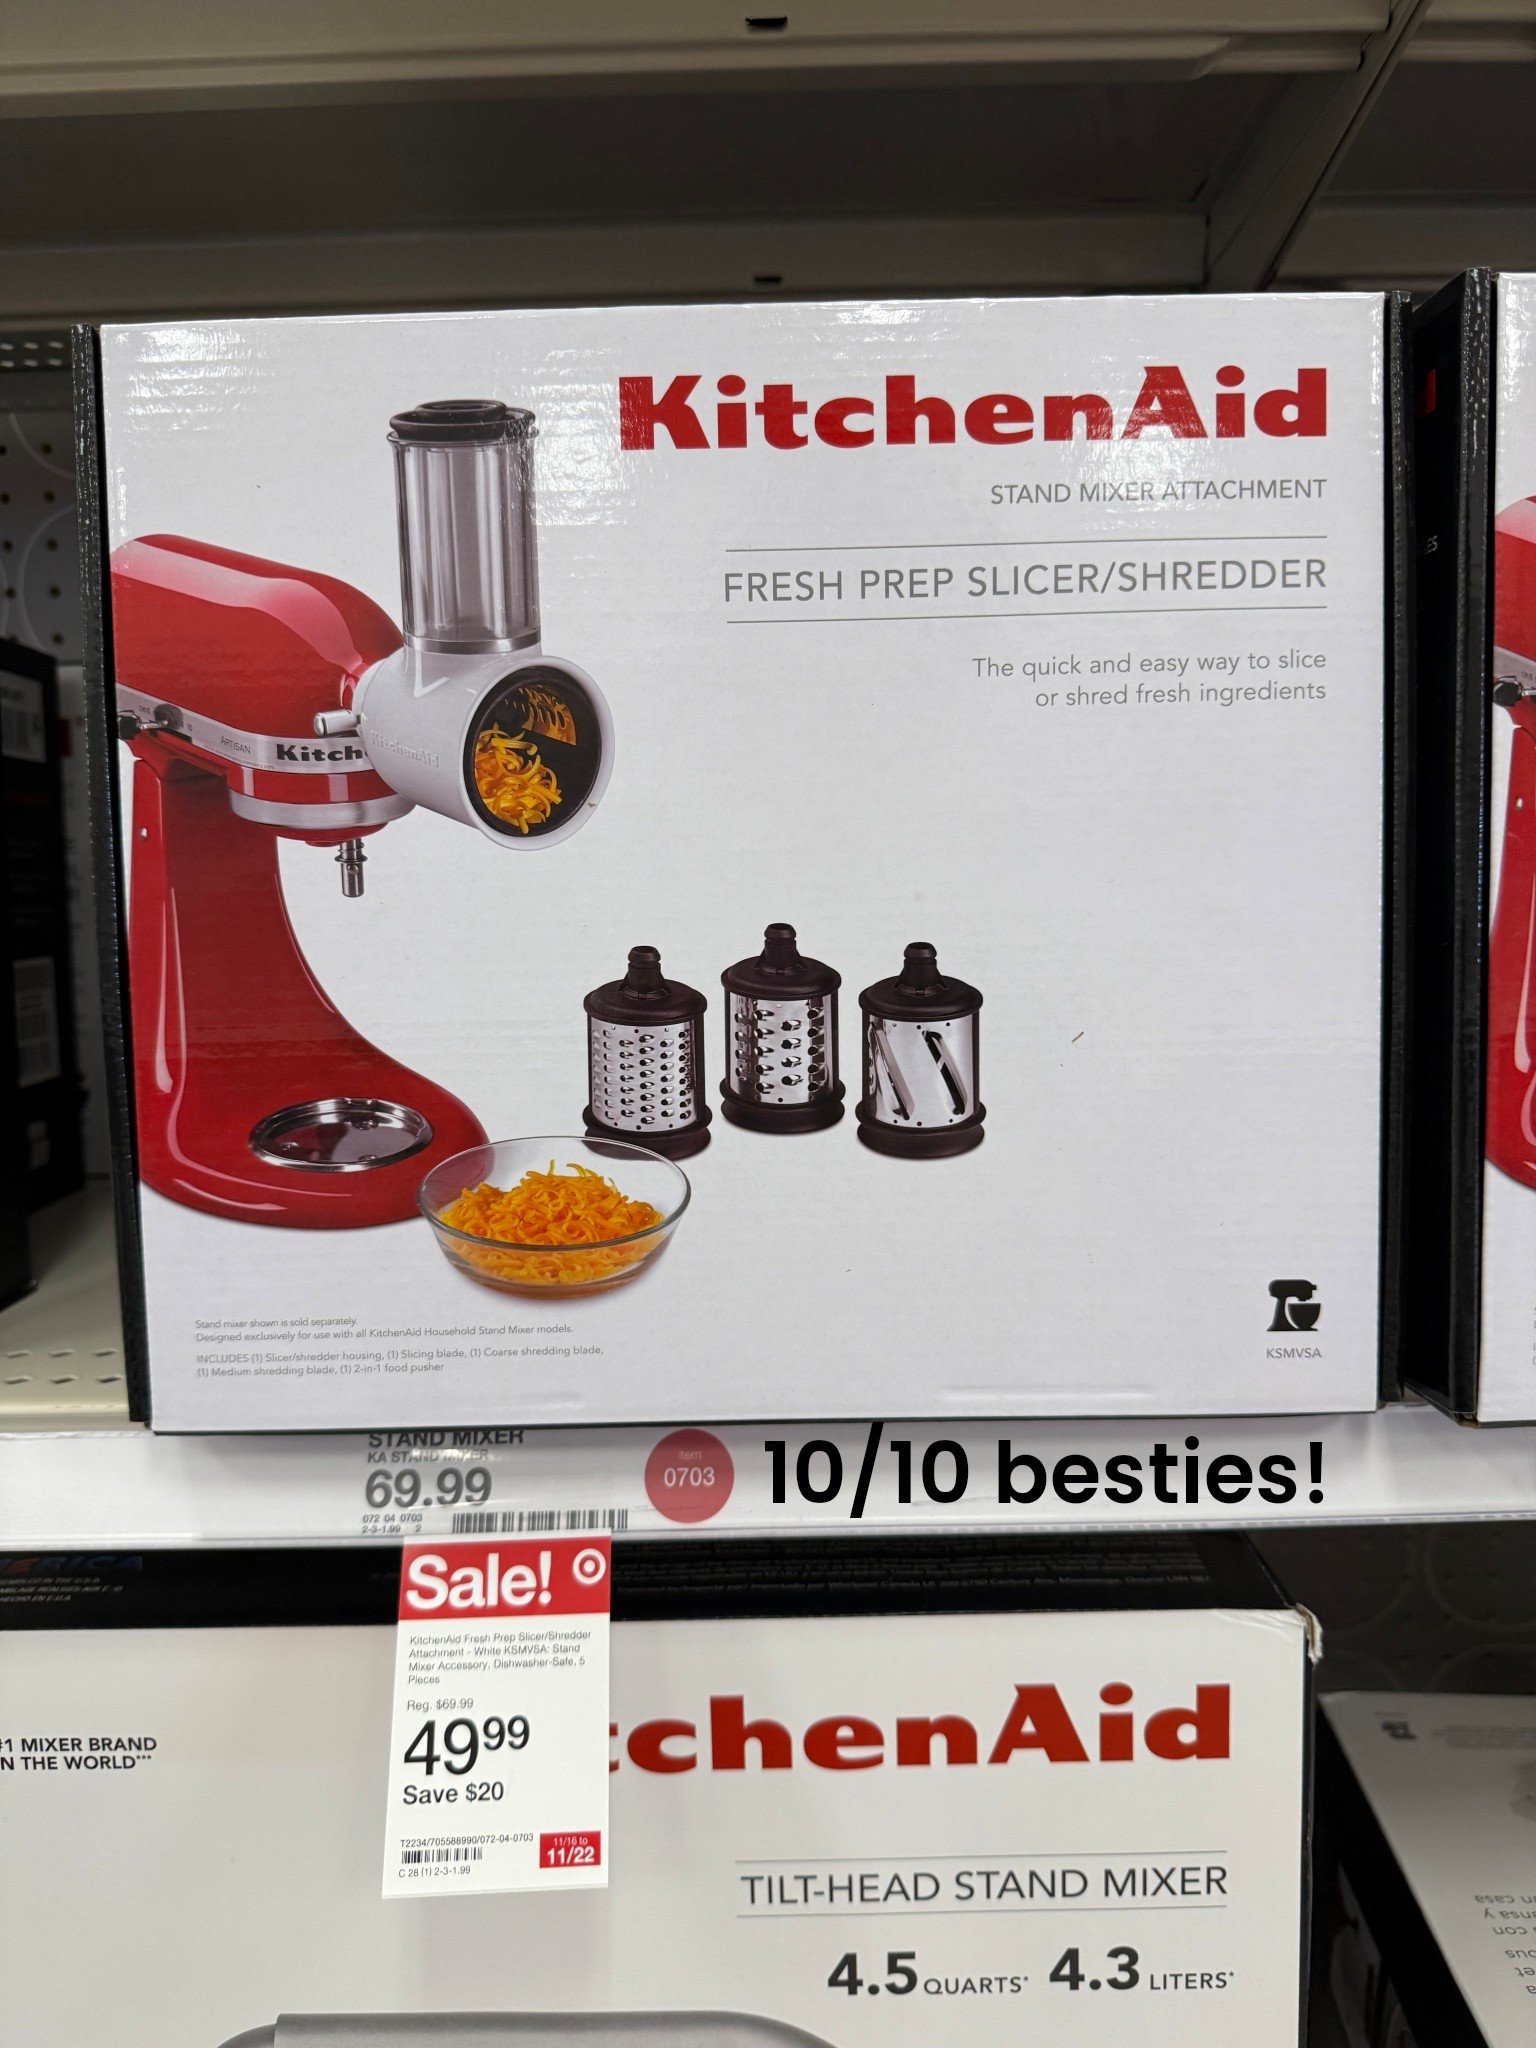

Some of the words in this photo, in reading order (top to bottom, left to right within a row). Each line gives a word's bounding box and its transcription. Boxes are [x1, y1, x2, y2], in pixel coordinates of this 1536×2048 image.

[619, 365, 1327, 451] KitchenAid
[991, 483, 1071, 505] STAND
[1080, 481, 1155, 503] MIXER
[1163, 479, 1327, 501] ATTACHMENT
[725, 571, 842, 602] FRESH
[861, 568, 953, 599] PREP
[968, 558, 1326, 597] SLICER/SHREDDER
[972, 658, 1014, 678] The
[1022, 654, 1082, 682] quick
[1090, 652, 1131, 674] and
[1140, 656, 1189, 677] easy
[1197, 653, 1240, 675] way
[1249, 652, 1270, 670] to
[1278, 648, 1326, 669] slice
[1036, 690, 1058, 707] or
[1066, 684, 1128, 706] shred
[1136, 682, 1190, 704] fresh
[1200, 680, 1326, 707] ingredients
[220, 735, 251, 755] ARTISAN
[276, 743, 369, 762] Kitch
[195, 1319, 222, 1329] Stand
[223, 1319, 247, 1328] mixer
[250, 1318, 279, 1328] shown
[281, 1318, 288, 1327] is
[290, 1317, 309, 1327] sold
[311, 1316, 357, 1328] separately.
[196, 1332, 242, 1343] Designed
[244, 1330, 295, 1343] exclusively
[299, 1330, 312, 1340] for
[314, 1331, 330, 1340] use
[333, 1329, 353, 1339] with
[356, 1328, 367, 1338] all
[370, 1327, 422, 1338] KitchenAid
[424, 1326, 476, 1336] Household
[479, 1325, 506, 1335] Stand
[508, 1324, 535, 1334] Mixer
[537, 1323, 574, 1334] models.
[197, 1353, 250, 1364] INCLUDES
[251, 1353, 263, 1364] (1)
[266, 1351, 340, 1362] Slicer/shredder
[343, 1350, 385, 1362] housing,
[387, 1350, 399, 1360] (1)
[401, 1349, 434, 1360] Slicing
[437, 1348, 467, 1359] blade,
[470, 1347, 482, 1358] (1)
[484, 1347, 518, 1357] Coarse
[521, 1346, 571, 1357] shredding
[573, 1345, 604, 1356] blade,
[1266, 1347, 1322, 1359] KSMVSA
[197, 1367, 209, 1378] (1)
[212, 1366, 251, 1376] Medium
[254, 1365, 304, 1377] shredding
[307, 1365, 338, 1375] blade,
[340, 1365, 352, 1374] (1)
[354, 1363, 381, 1373] 2-in-1
[384, 1362, 408, 1372] food
[410, 1362, 444, 1373] pusher
[369, 1431, 446, 1448] STAND
[453, 1429, 524, 1446] MIXER
[367, 1451, 387, 1463] KA
[391, 1450, 439, 1463] STAND
[664, 1466, 715, 1488] 0703
[365, 1466, 492, 1508] 69.99
[362, 1514, 380, 1523] 072
[384, 1514, 396, 1523] 04
[400, 1513, 423, 1522] 0703
[362, 1524, 401, 1534] 2-3-1.99
[415, 1524, 421, 1533] 2
[406, 1550, 552, 1611] Sale!
[410, 1635, 461, 1645] KitchenAid
[464, 1633, 491, 1643] Fresh
[493, 1632, 516, 1645] Prep
[518, 1630, 592, 1642] Slicer/Shredder
[409, 1647, 464, 1658] Attachment
[474, 1645, 501, 1656] White
[504, 1644, 550, 1655] KSMVSA:
[553, 1643, 581, 1653] Stand
[408, 1661, 435, 1672] Mixer
[438, 1658, 491, 1672] Accessory,
[493, 1656, 577, 1669] Dishwasher-Safe,
[579, 1655, 586, 1665] 5
[408, 1674, 440, 1684] Pieces
[407, 1699, 433, 1712] Reg.
[436, 1697, 474, 1710] $69.99
[21, 1738, 83, 1752] MIXER
[89, 1736, 157, 1751] BRAND
[20, 1756, 58, 1770] THE
[402, 1784, 458, 1805] Save
[465, 1781, 504, 1803] $20
[400, 1832, 534, 1848] T2234/705588990/072-04-0703
[553, 1836, 577, 1846] 11/16
[578, 1836, 588, 1845] to
[547, 1847, 595, 1865] 11/22
[399, 1869, 406, 1878] C
[408, 1868, 419, 1877] 28
[421, 1866, 432, 1877] (1)
[434, 1865, 471, 1876] 2-3-1.99
[740, 1872, 940, 1905] TILT-HEAD
[954, 1869, 1088, 1901] STAND
[1102, 1866, 1228, 1898] MIXER
[1475, 1894, 1515, 1904] casa
[1493, 1926, 1527, 1935] con
[827, 1950, 918, 1997] 4.5
[1049, 1946, 1140, 1991] 4.3
[1514, 1967, 1536, 1977] et
